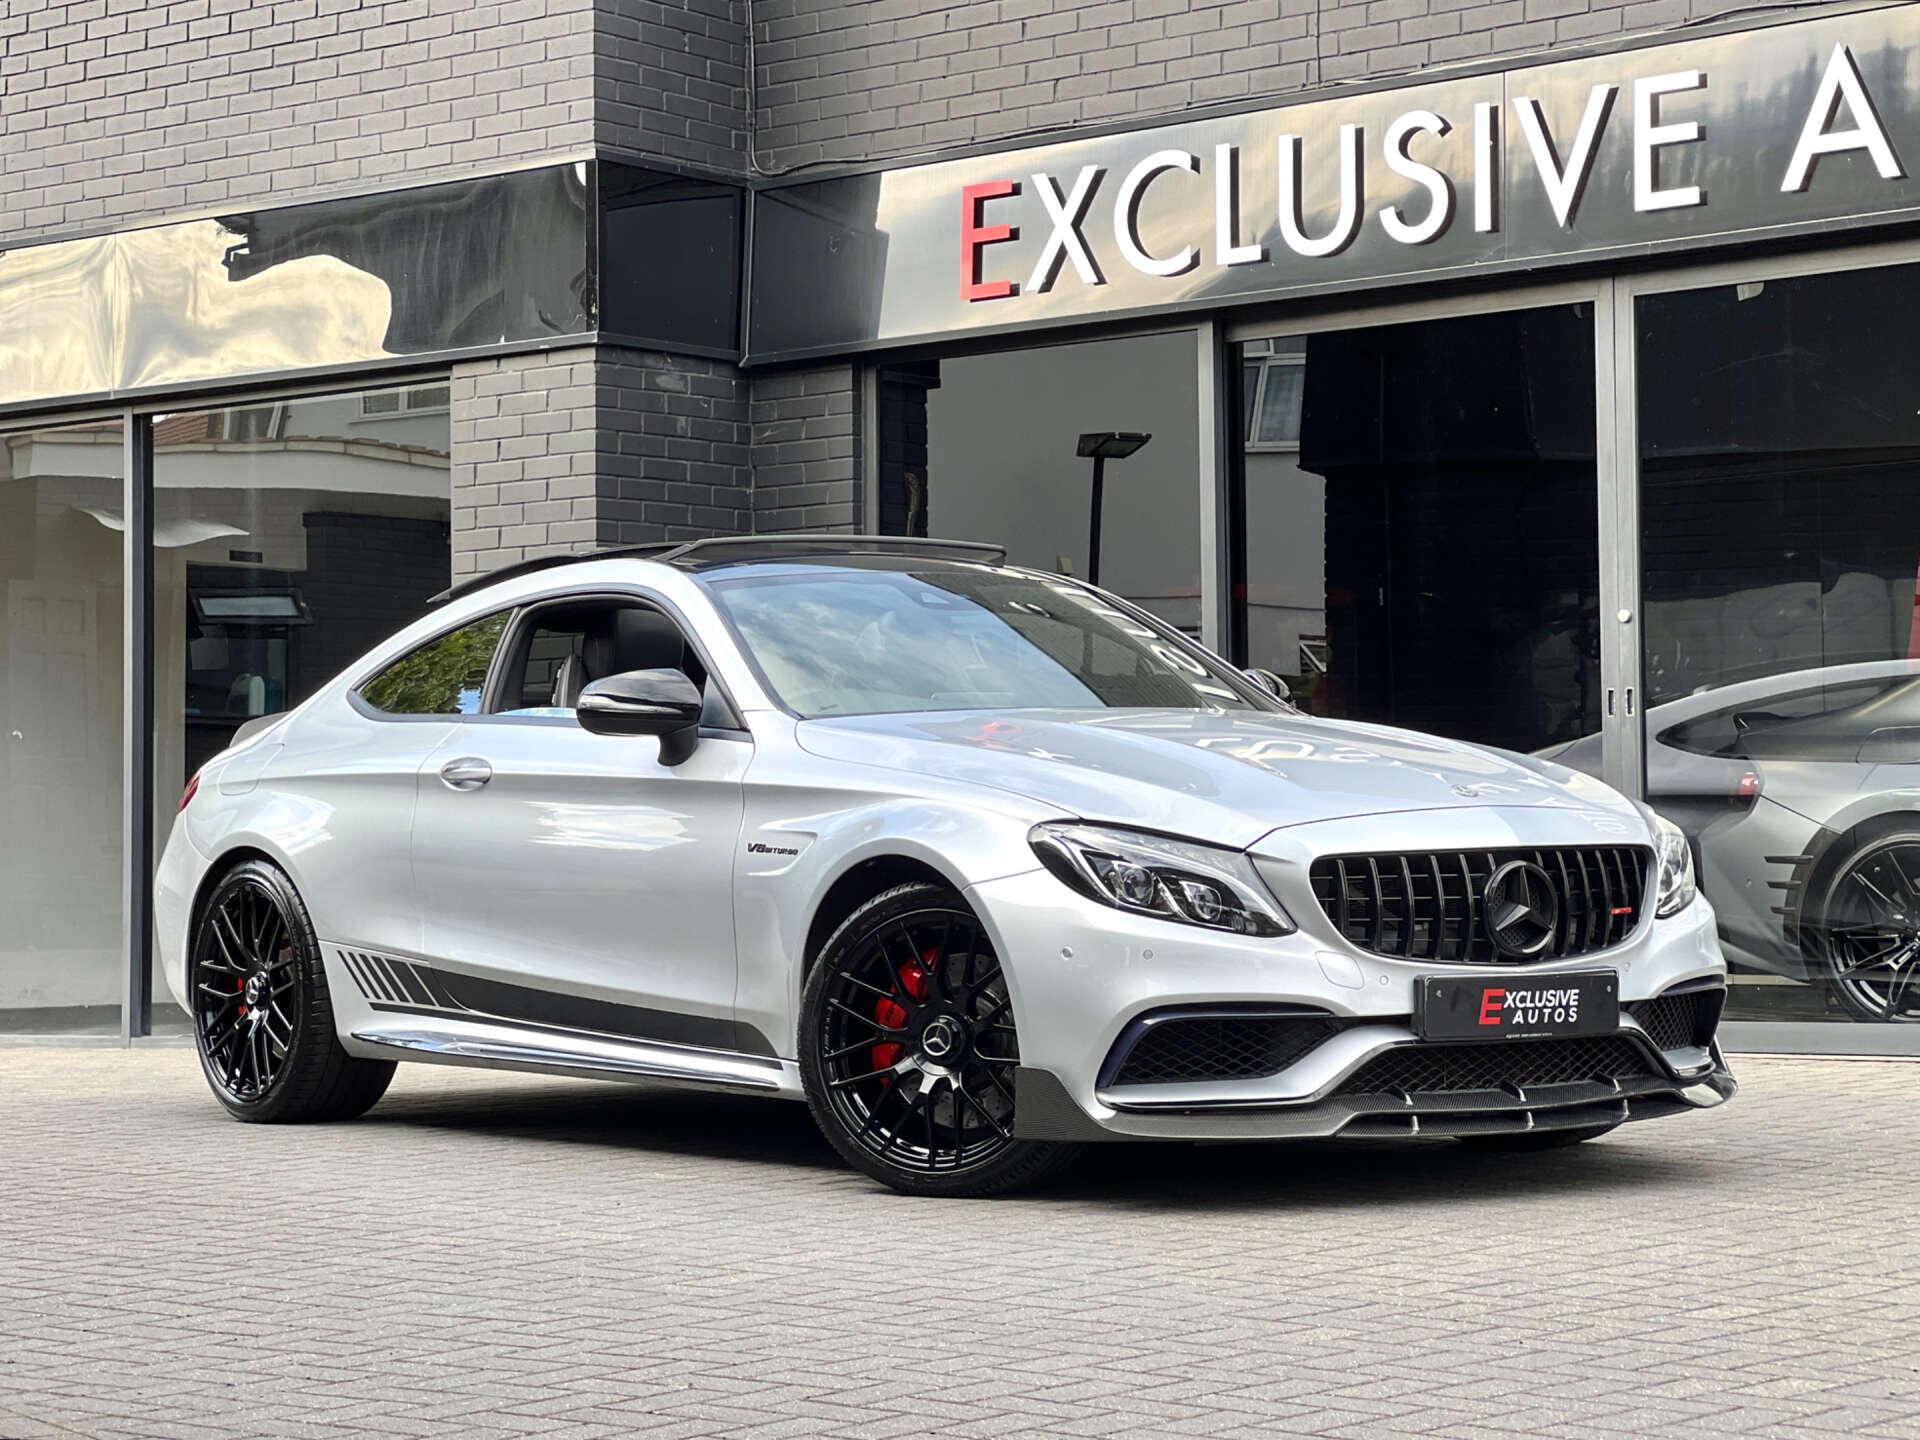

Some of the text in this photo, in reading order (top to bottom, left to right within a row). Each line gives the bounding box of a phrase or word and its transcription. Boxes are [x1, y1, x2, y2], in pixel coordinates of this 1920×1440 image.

[959, 69, 1706, 302] EXCLUSIVE
[1479, 988, 1580, 1024] EXCLUSIVE
[1512, 1007, 1578, 1024] AUTOS
